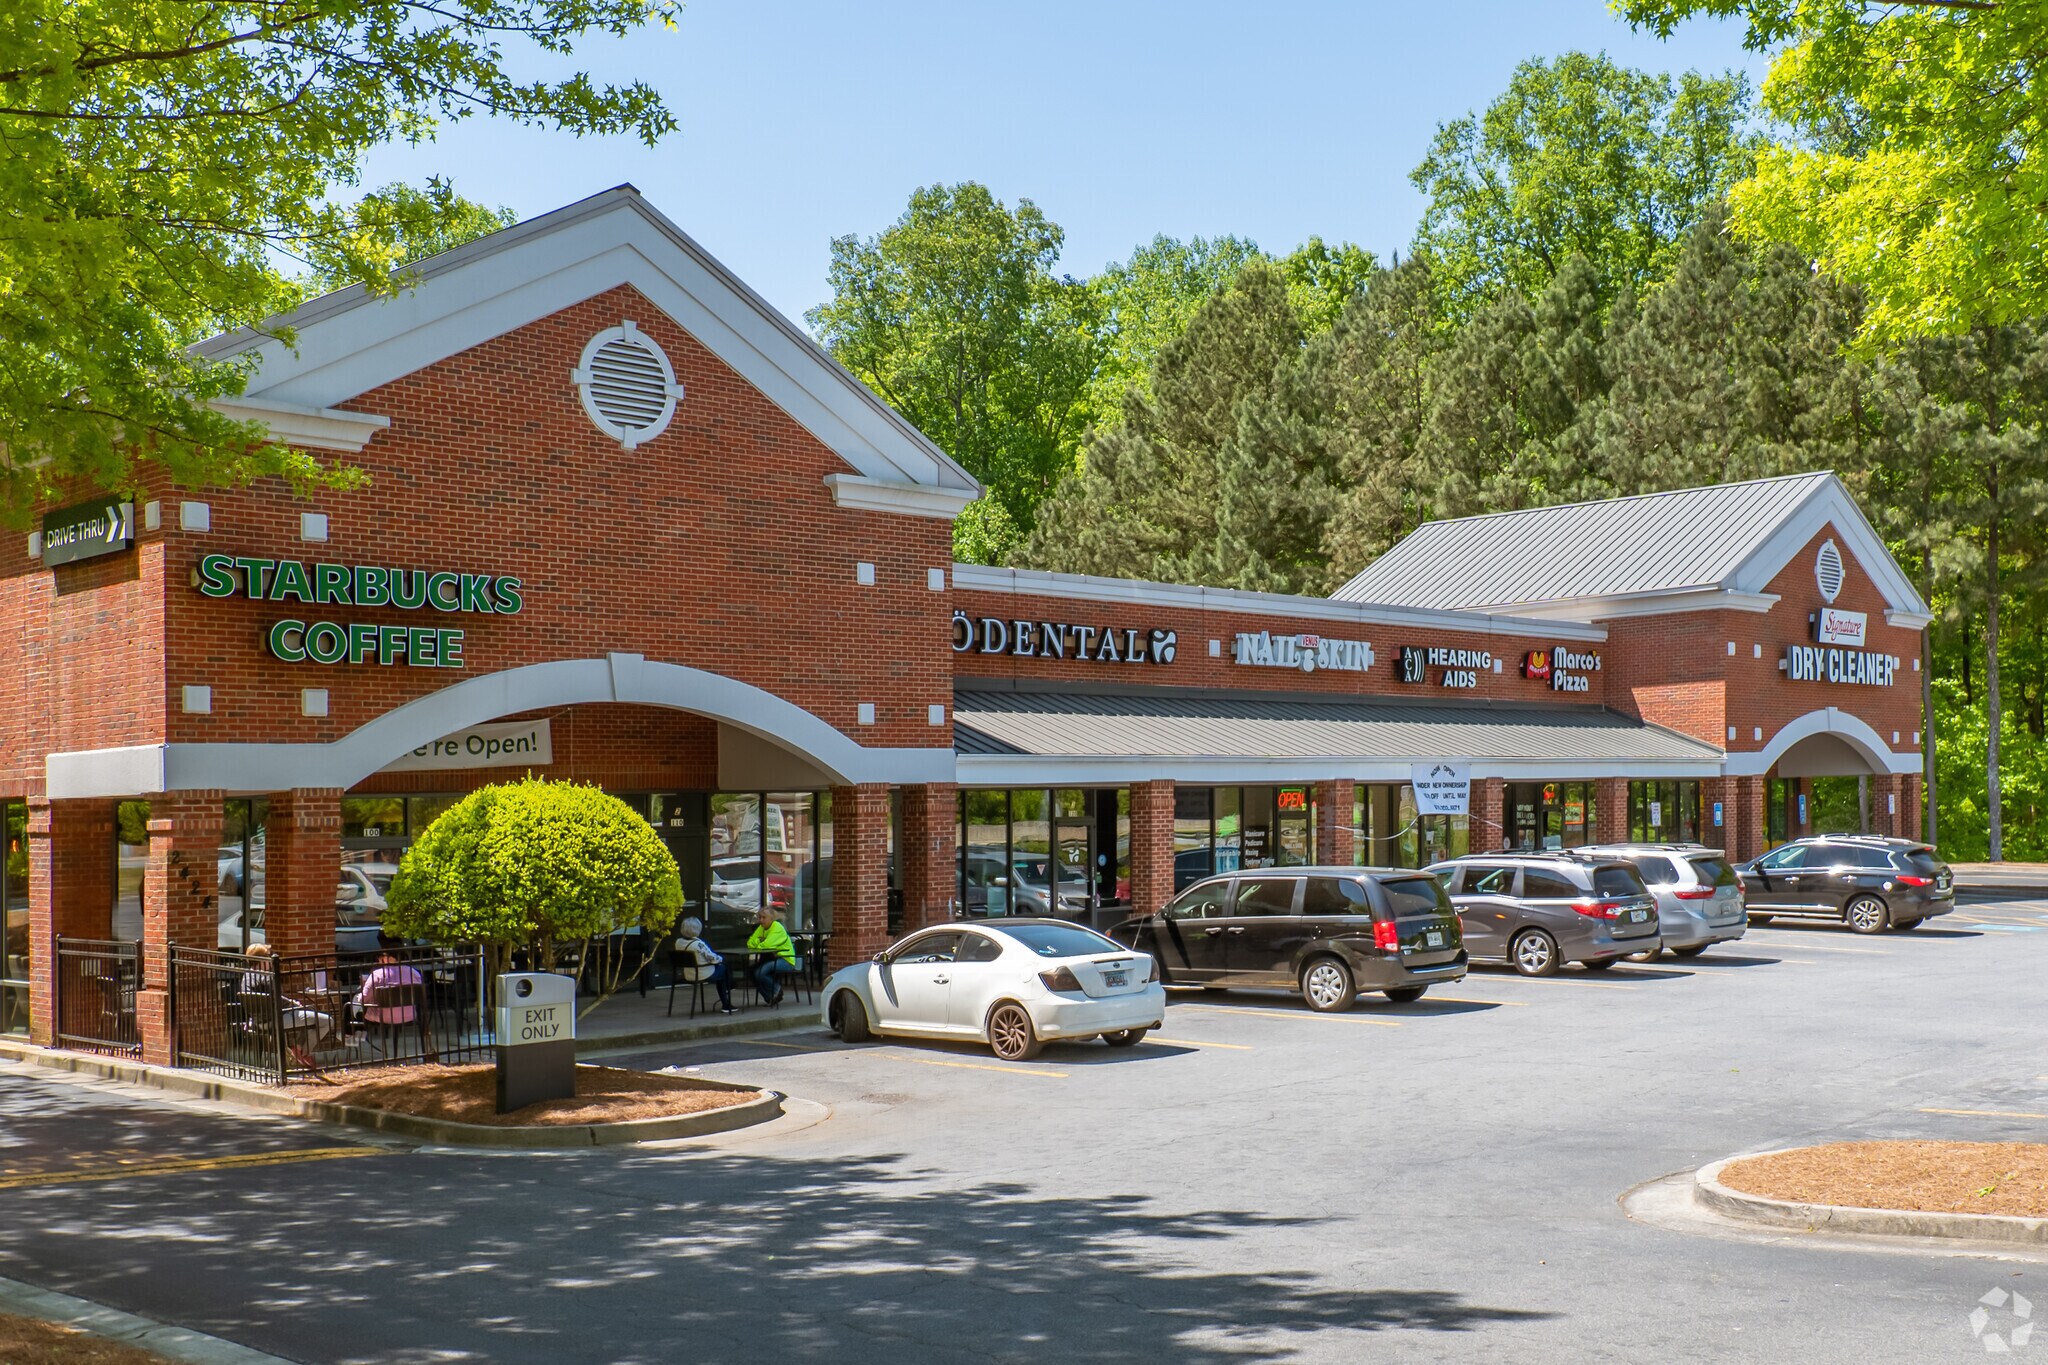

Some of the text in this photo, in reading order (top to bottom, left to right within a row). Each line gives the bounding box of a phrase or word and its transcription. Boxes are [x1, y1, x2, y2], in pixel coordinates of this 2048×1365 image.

[47, 517, 105, 549] DRIVE THRU
[200, 553, 524, 614] STARBUCKS
[1825, 611, 1862, 641] Signature
[270, 619, 464, 667] COFFEE
[1235, 631, 1300, 668] NAIL
[1317, 638, 1371, 672] SKIN
[1302, 636, 1319, 647] VENUS
[1404, 647, 1413, 682] ACA
[1428, 647, 1491, 669] HEARING
[1554, 646, 1601, 671] Marco's
[1791, 645, 1894, 687] DRY CLEANER
[1443, 670, 1477, 689] AIDS
[1554, 669, 1589, 692] Pizza
[465, 732, 537, 759] Open!
[1430, 764, 1456, 778] NOW OPEN
[1278, 792, 1305, 808] OPEN
[363, 828, 380, 837] 100
[525, 1008, 556, 1024] EXIT
[521, 1023, 560, 1040] ONLY
